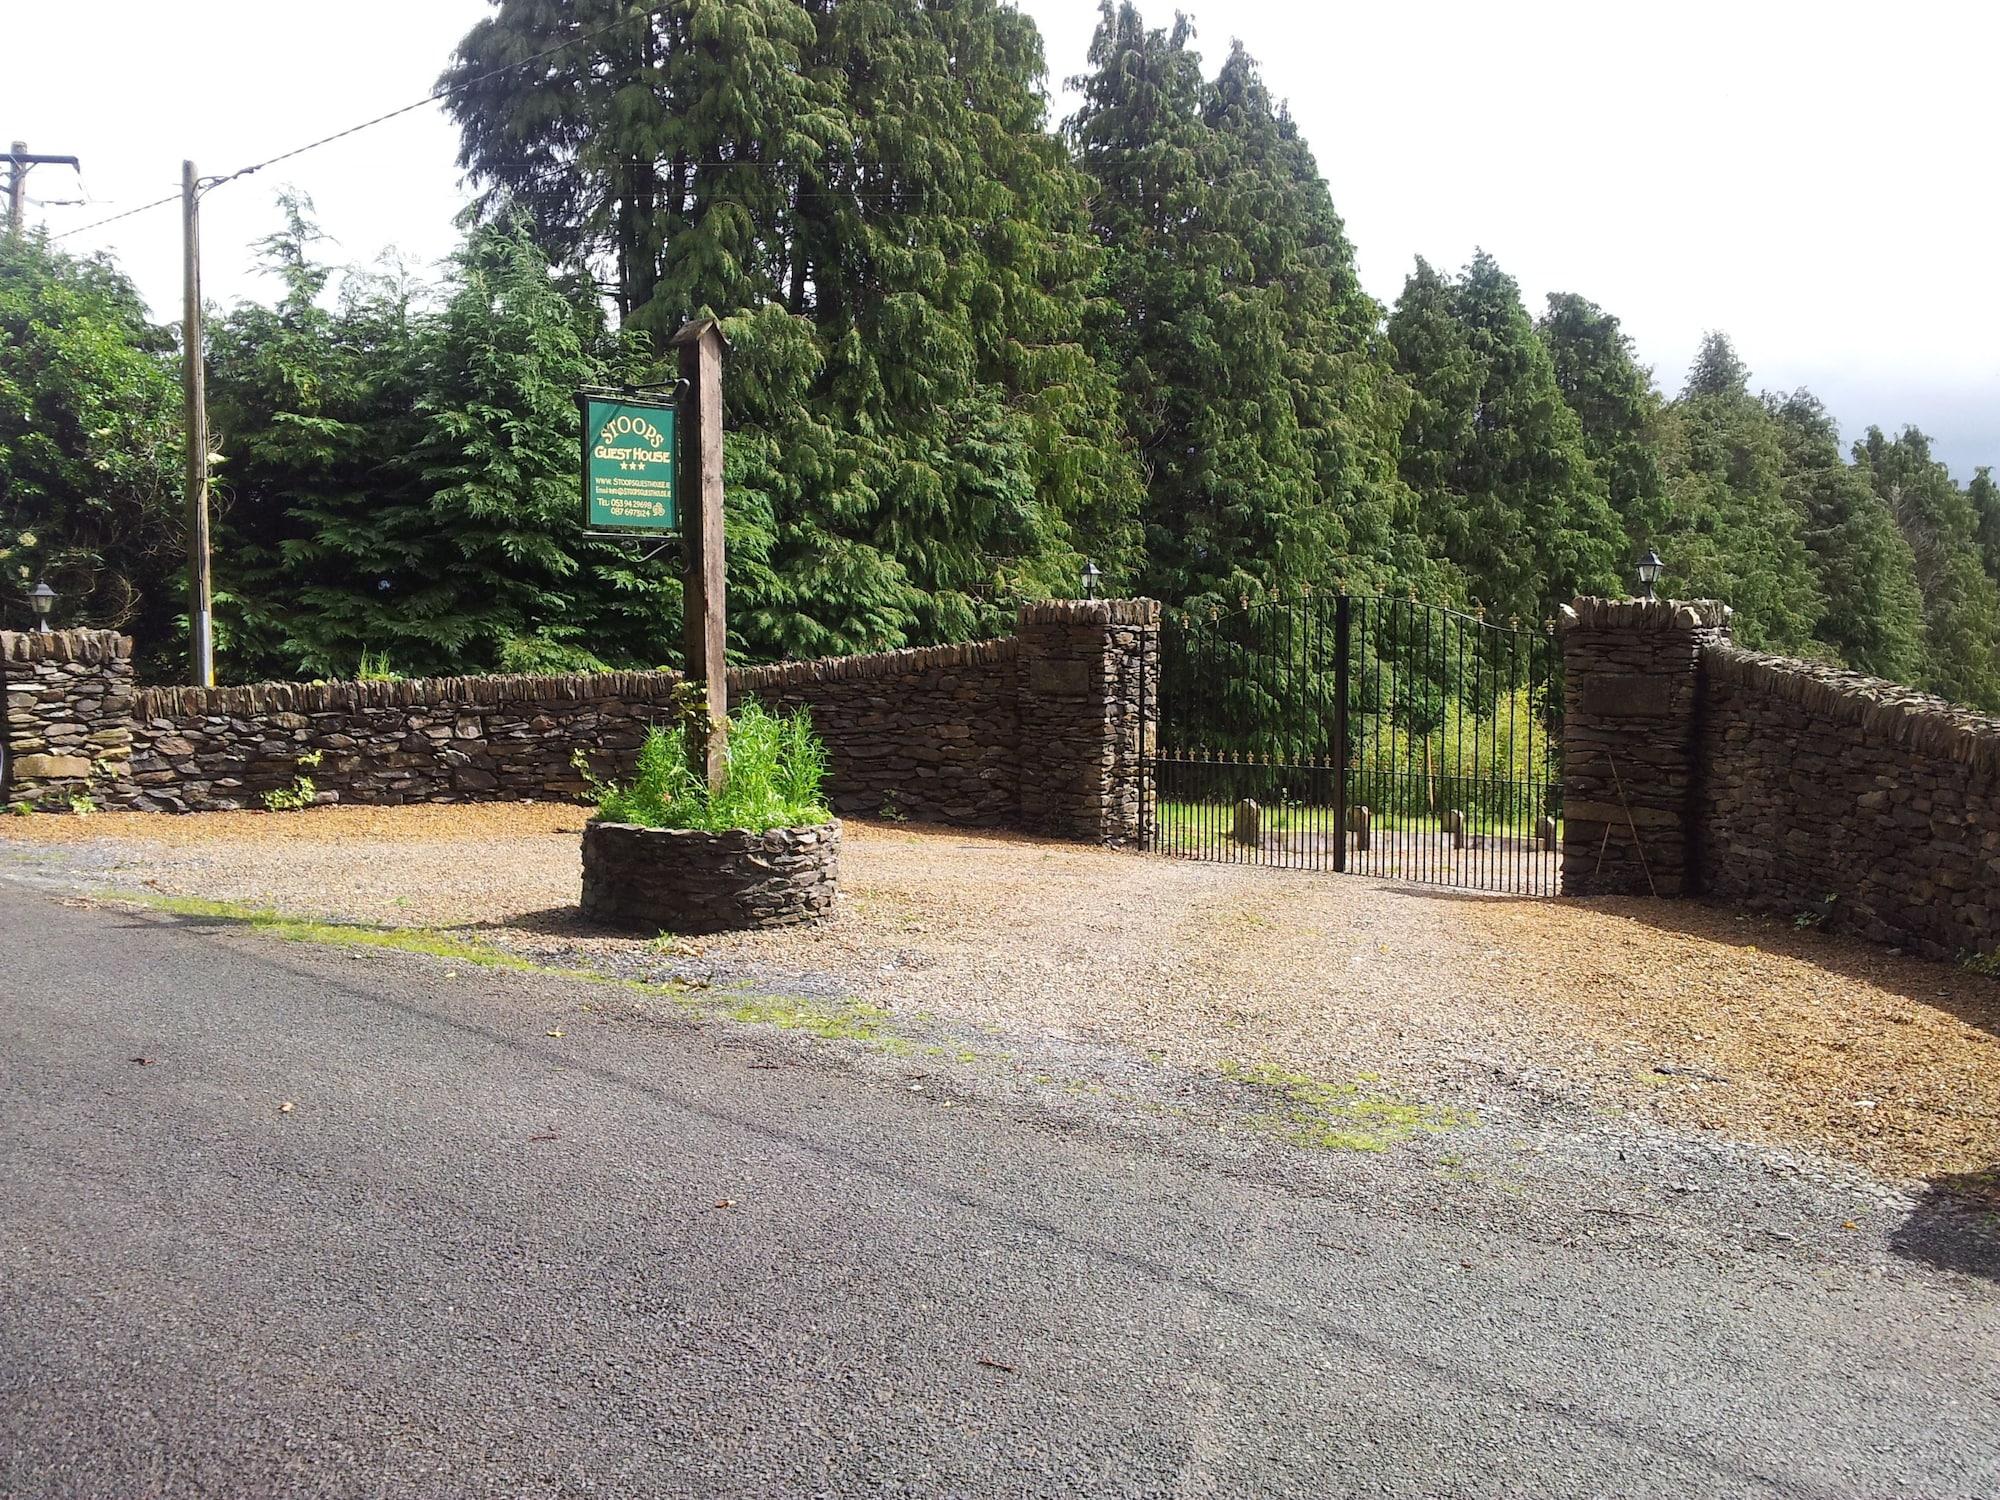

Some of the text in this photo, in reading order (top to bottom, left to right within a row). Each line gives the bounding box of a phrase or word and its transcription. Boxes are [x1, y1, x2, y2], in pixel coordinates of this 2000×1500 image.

[600, 416, 664, 447] STOOPS
[594, 446, 671, 463] GUEST HOUSE
